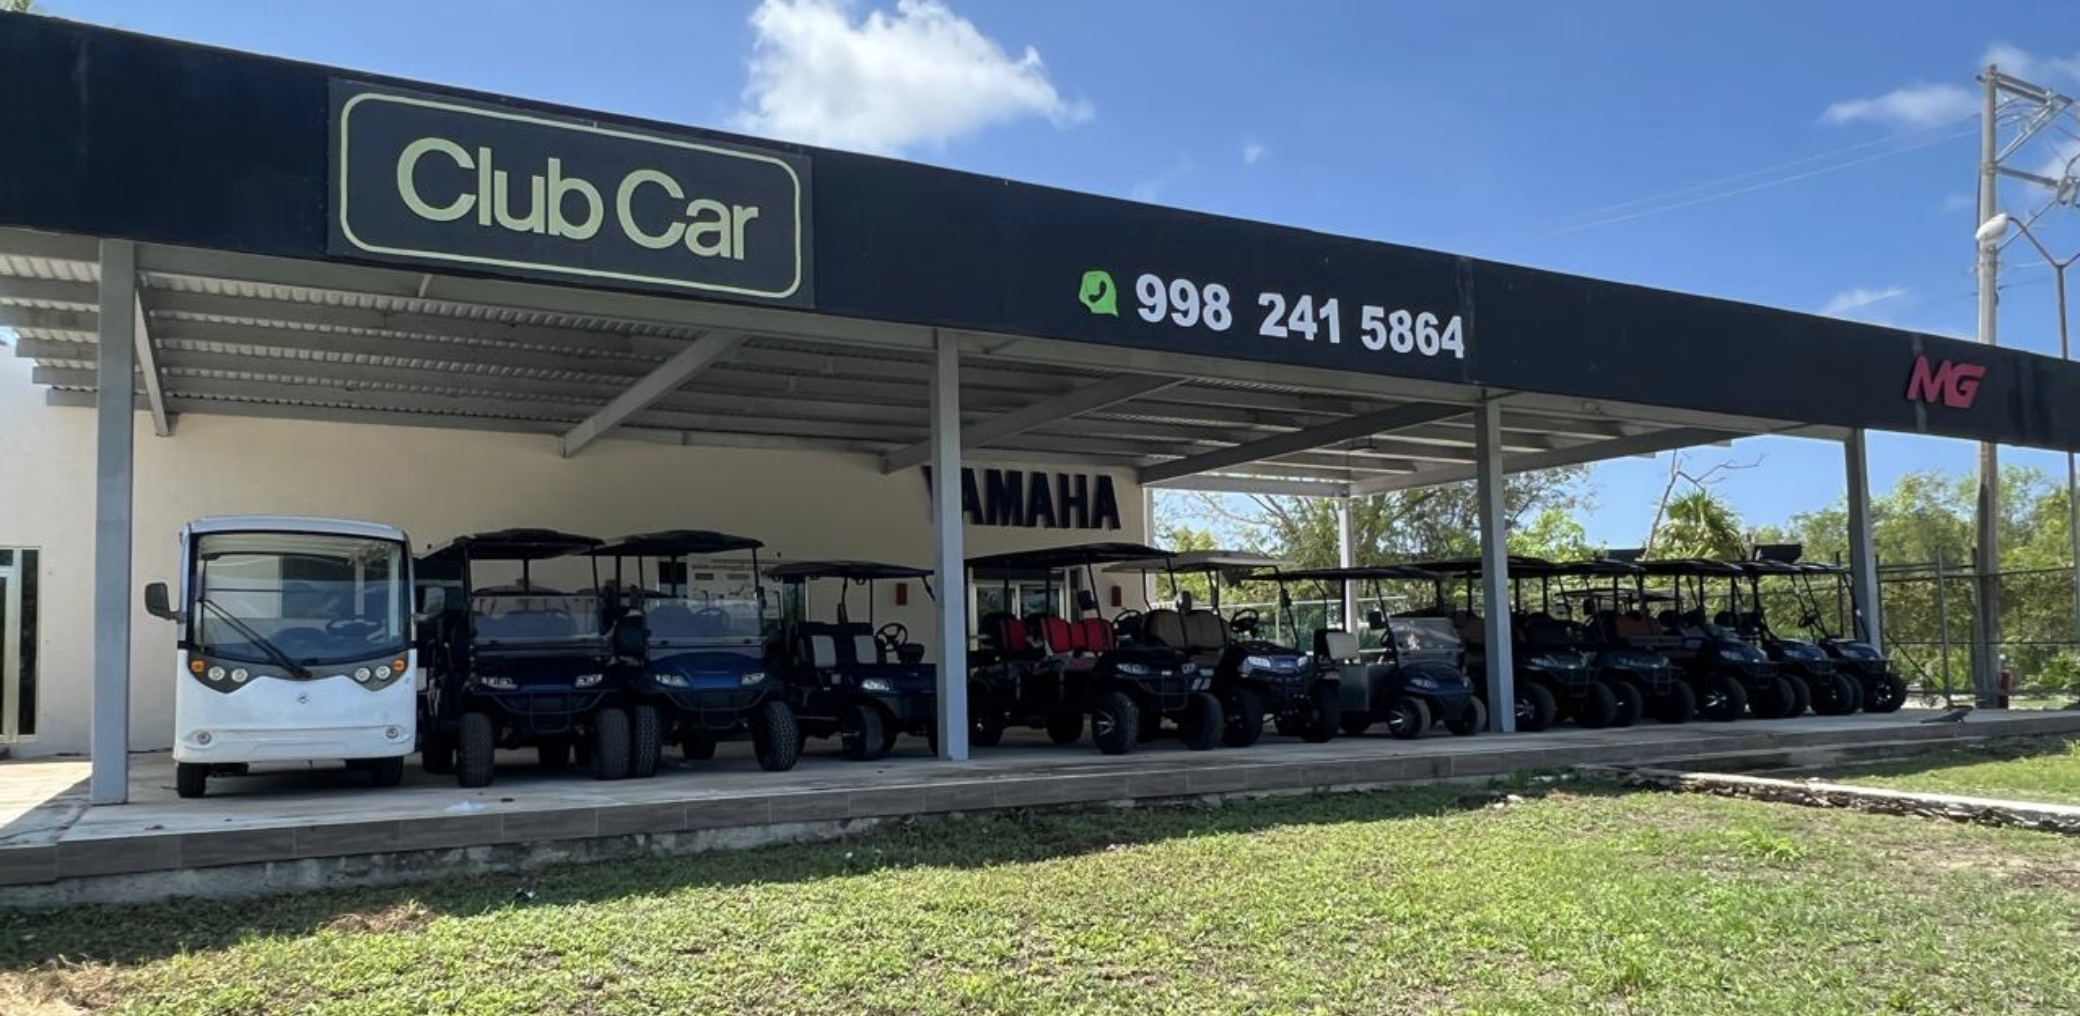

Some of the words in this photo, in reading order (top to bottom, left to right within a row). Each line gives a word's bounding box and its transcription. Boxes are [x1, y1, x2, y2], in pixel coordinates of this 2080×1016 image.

[396, 137, 604, 240] Club
[616, 169, 759, 260] Car
[1135, 273, 1232, 331] 998
[1258, 292, 1340, 343] 241
[1361, 305, 1464, 358] 5864
[1907, 354, 1986, 408] MG
